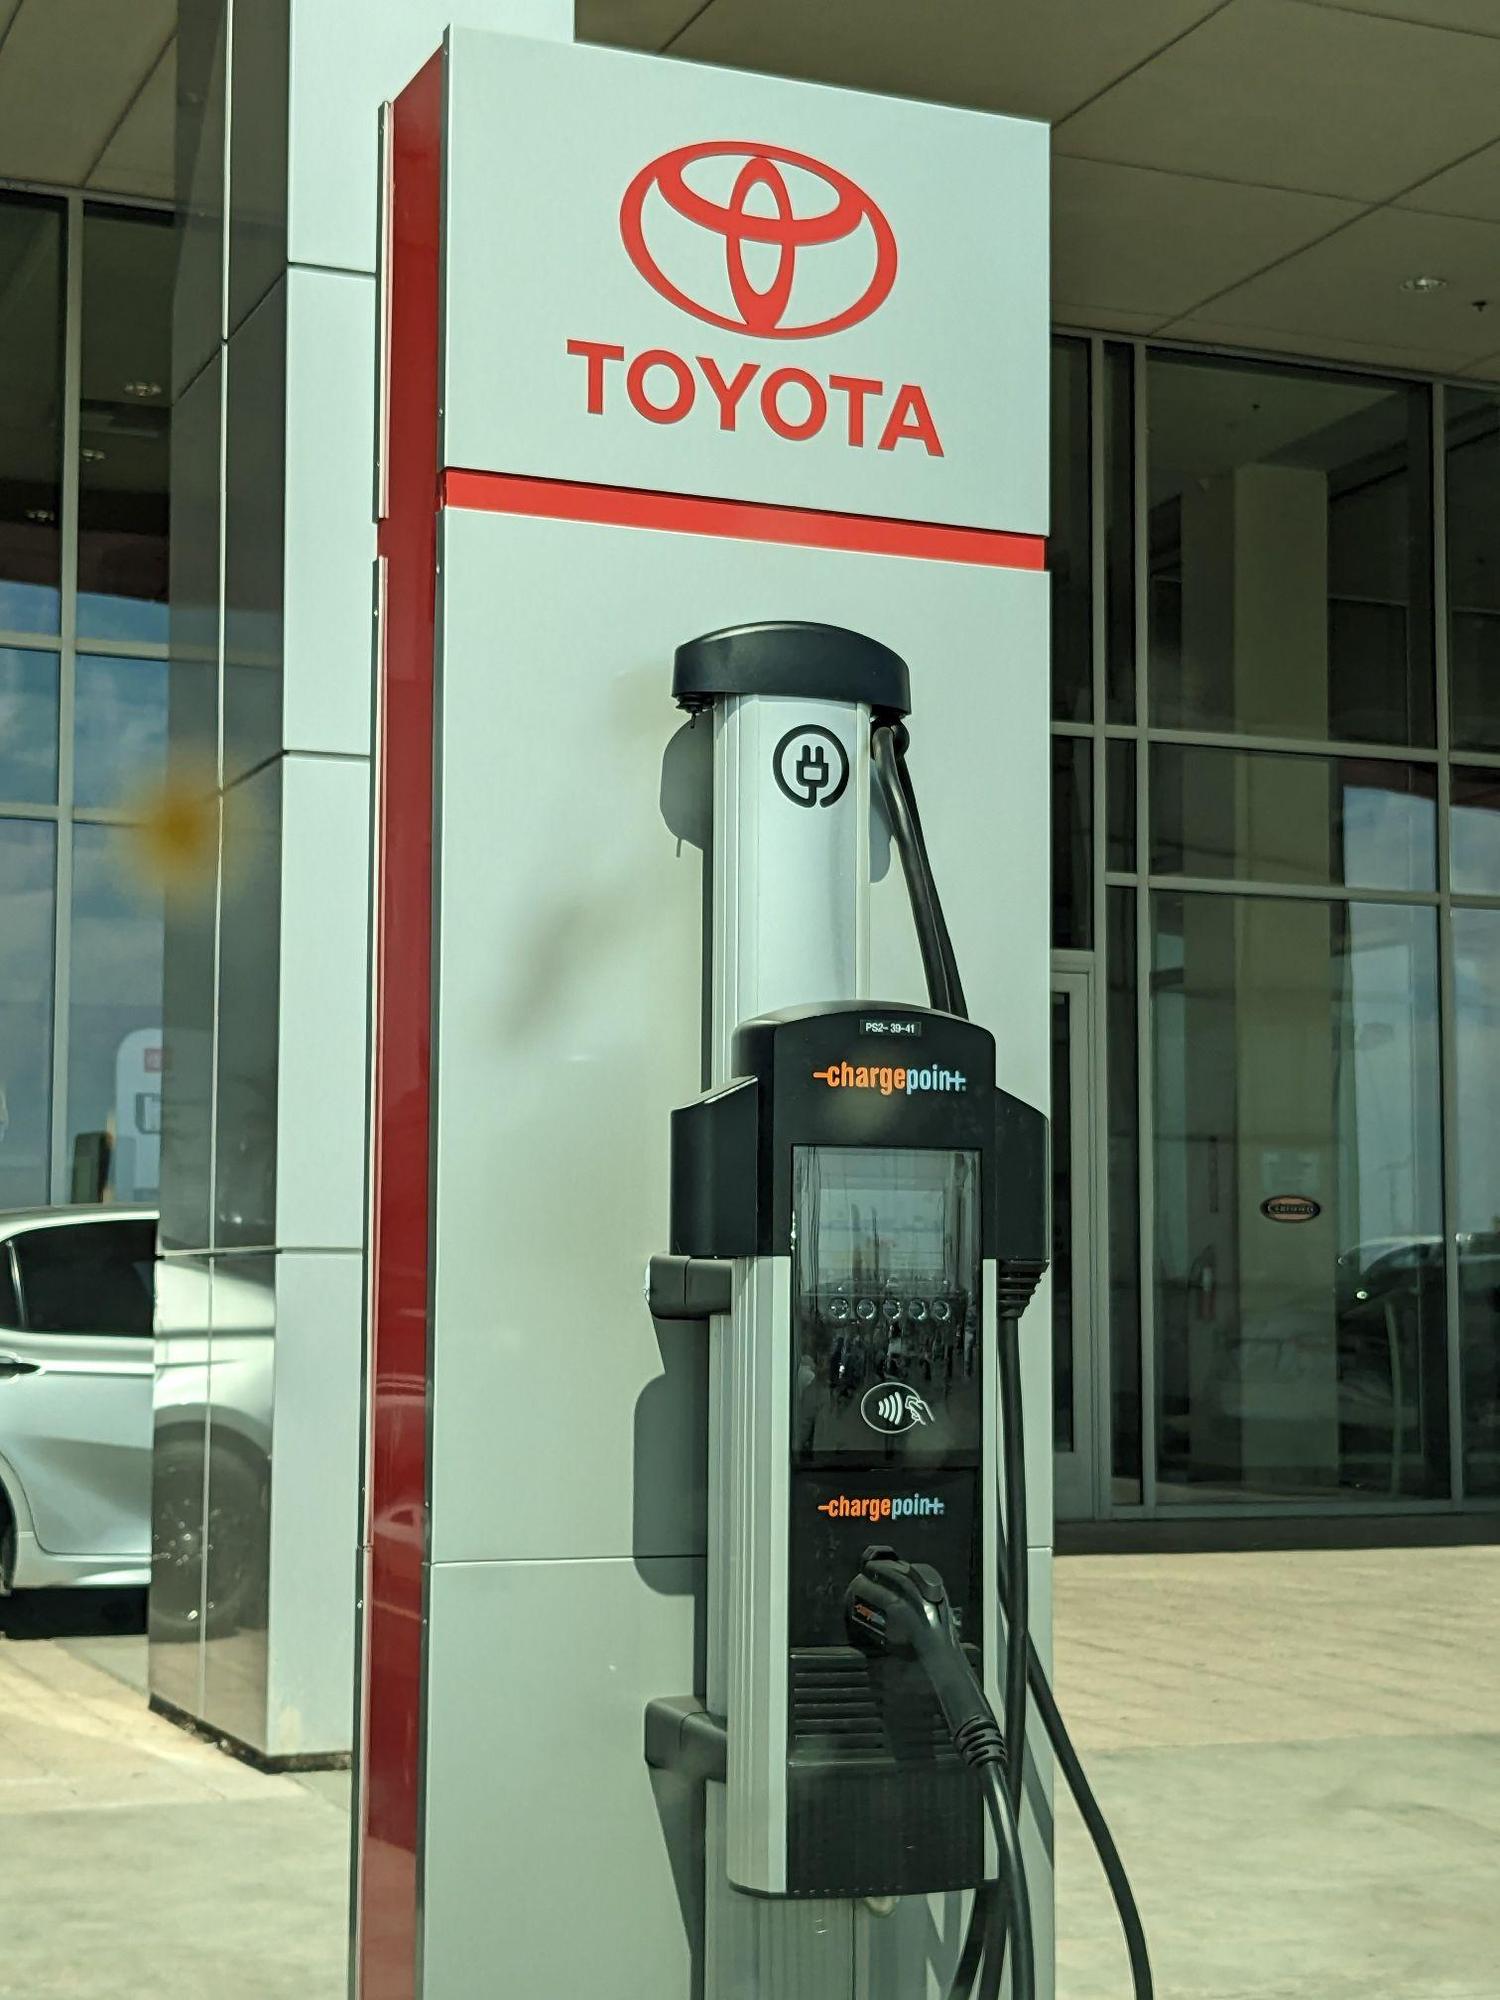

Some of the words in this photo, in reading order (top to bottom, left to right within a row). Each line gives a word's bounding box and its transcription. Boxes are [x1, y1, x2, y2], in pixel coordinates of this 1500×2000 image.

[567, 339, 944, 458] TOYOTA
[813, 1061, 966, 1095] chargepoint
[817, 1493, 945, 1521] chargepoint
